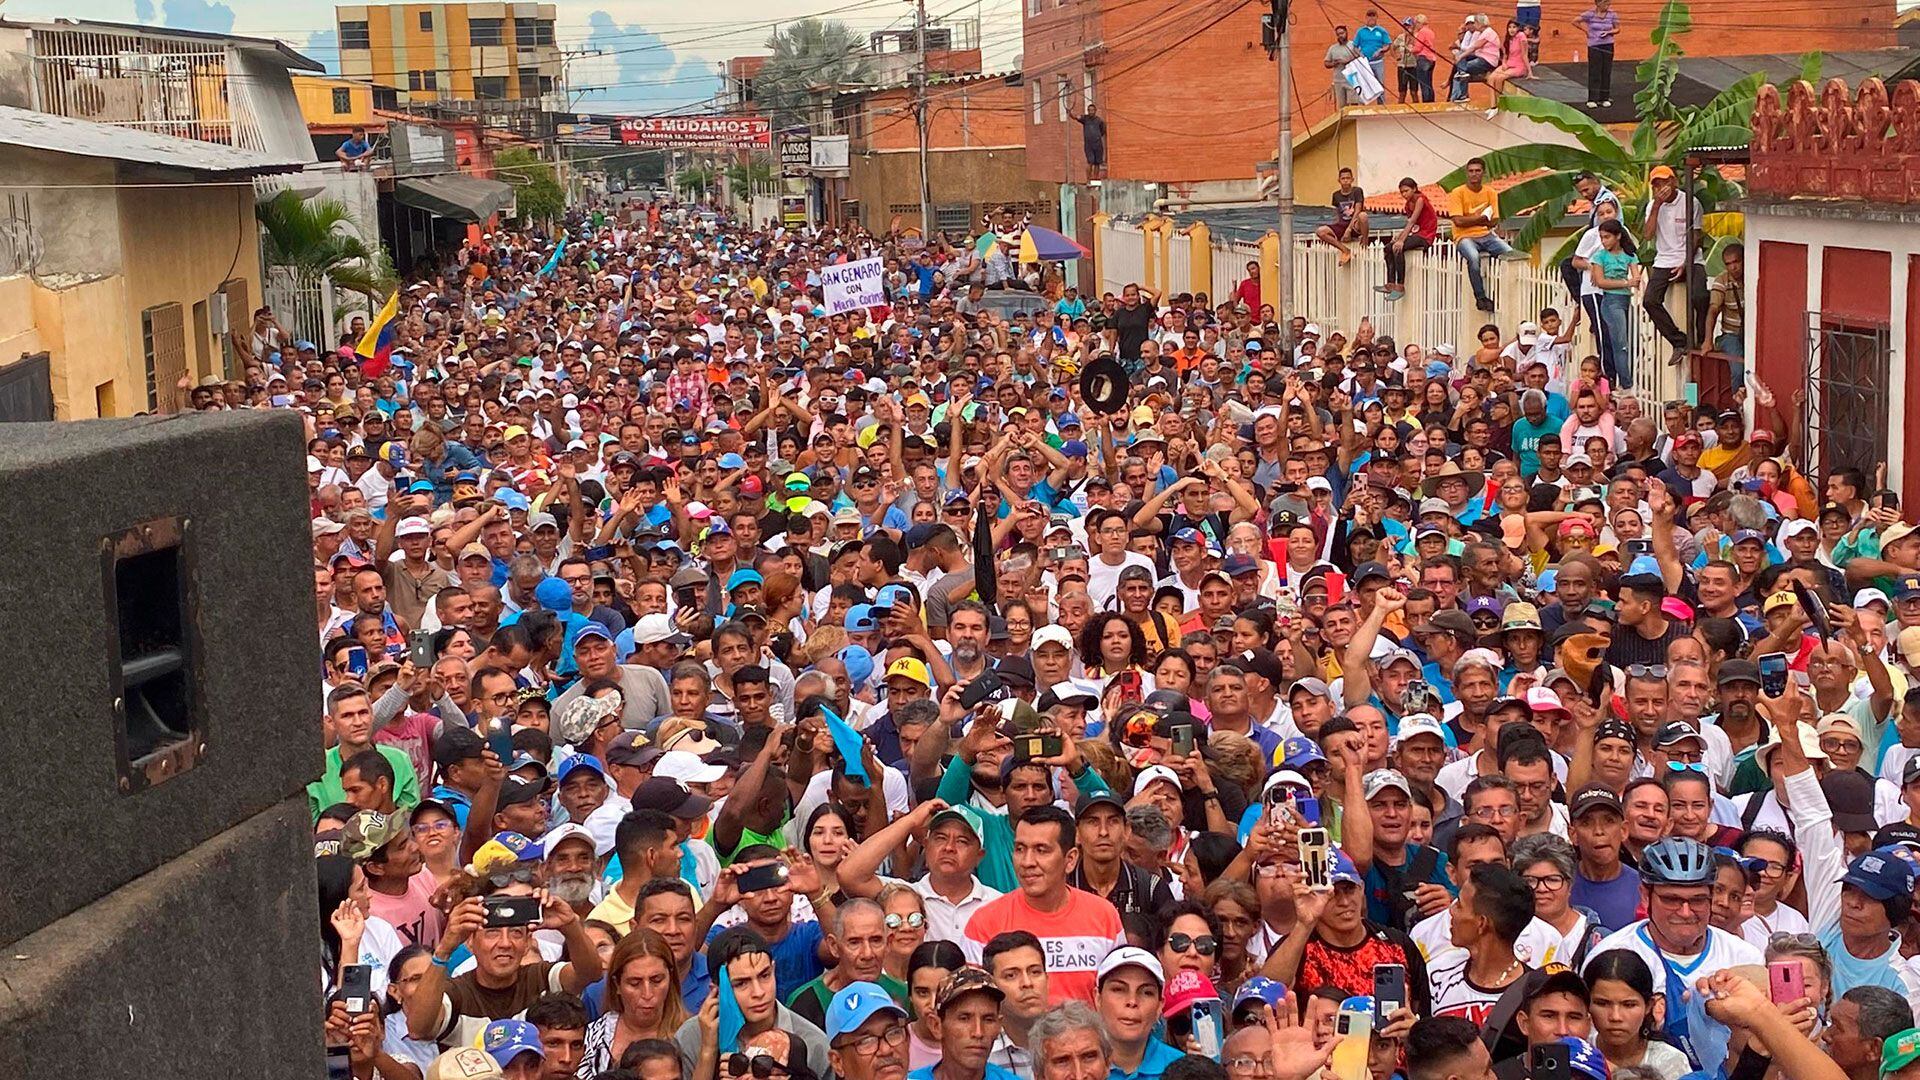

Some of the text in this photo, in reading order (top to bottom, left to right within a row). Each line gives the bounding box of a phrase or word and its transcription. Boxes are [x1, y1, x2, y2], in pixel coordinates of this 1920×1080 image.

[620, 118, 750, 133] NOS MUDAMOS
[781, 142, 809, 155] AVISOS
[822, 262, 881, 287] SAN GENARO
[846, 282, 863, 295] CON
[859, 291, 884, 305] Corina
[1046, 940, 1063, 953] ES
[1048, 955, 1096, 968] JEANS
